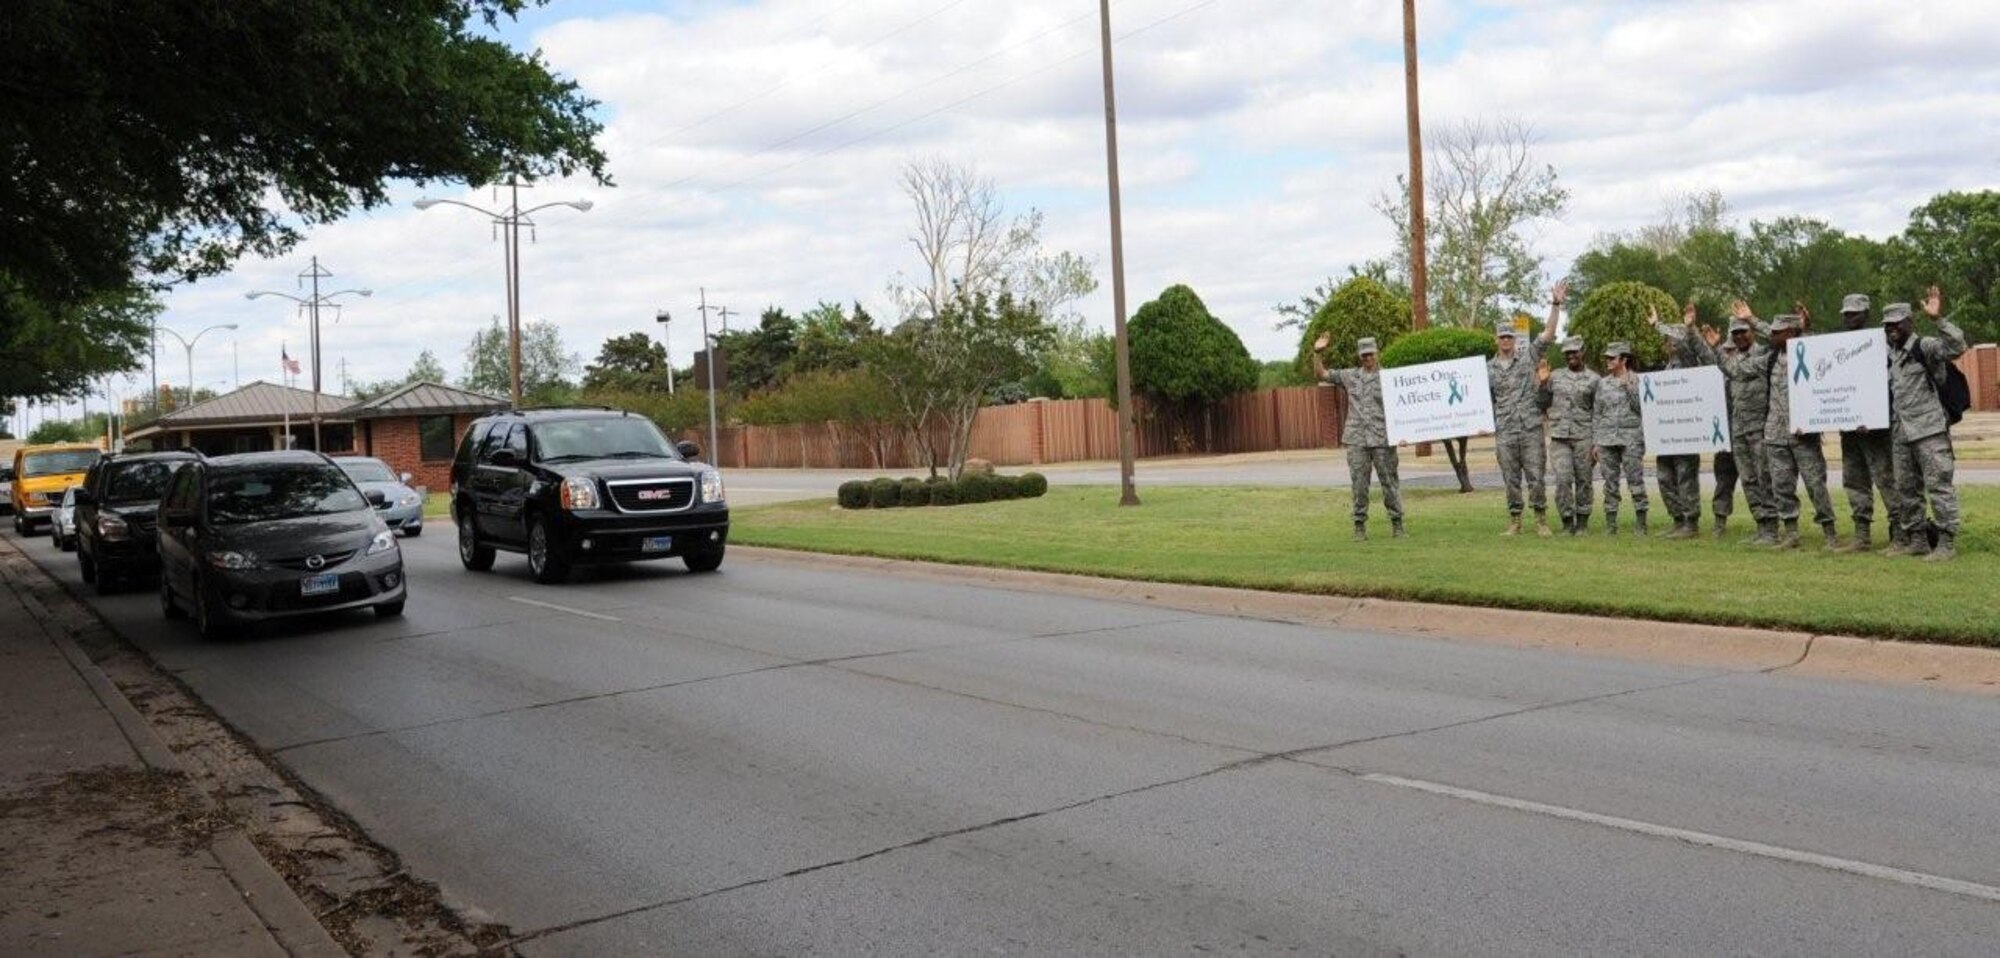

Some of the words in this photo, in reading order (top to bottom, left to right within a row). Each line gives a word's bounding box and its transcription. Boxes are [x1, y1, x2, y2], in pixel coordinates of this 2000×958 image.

[1393, 374, 1428, 388] Hurts
[1396, 390, 1442, 406] Affects
[638, 489, 671, 500] GMC
